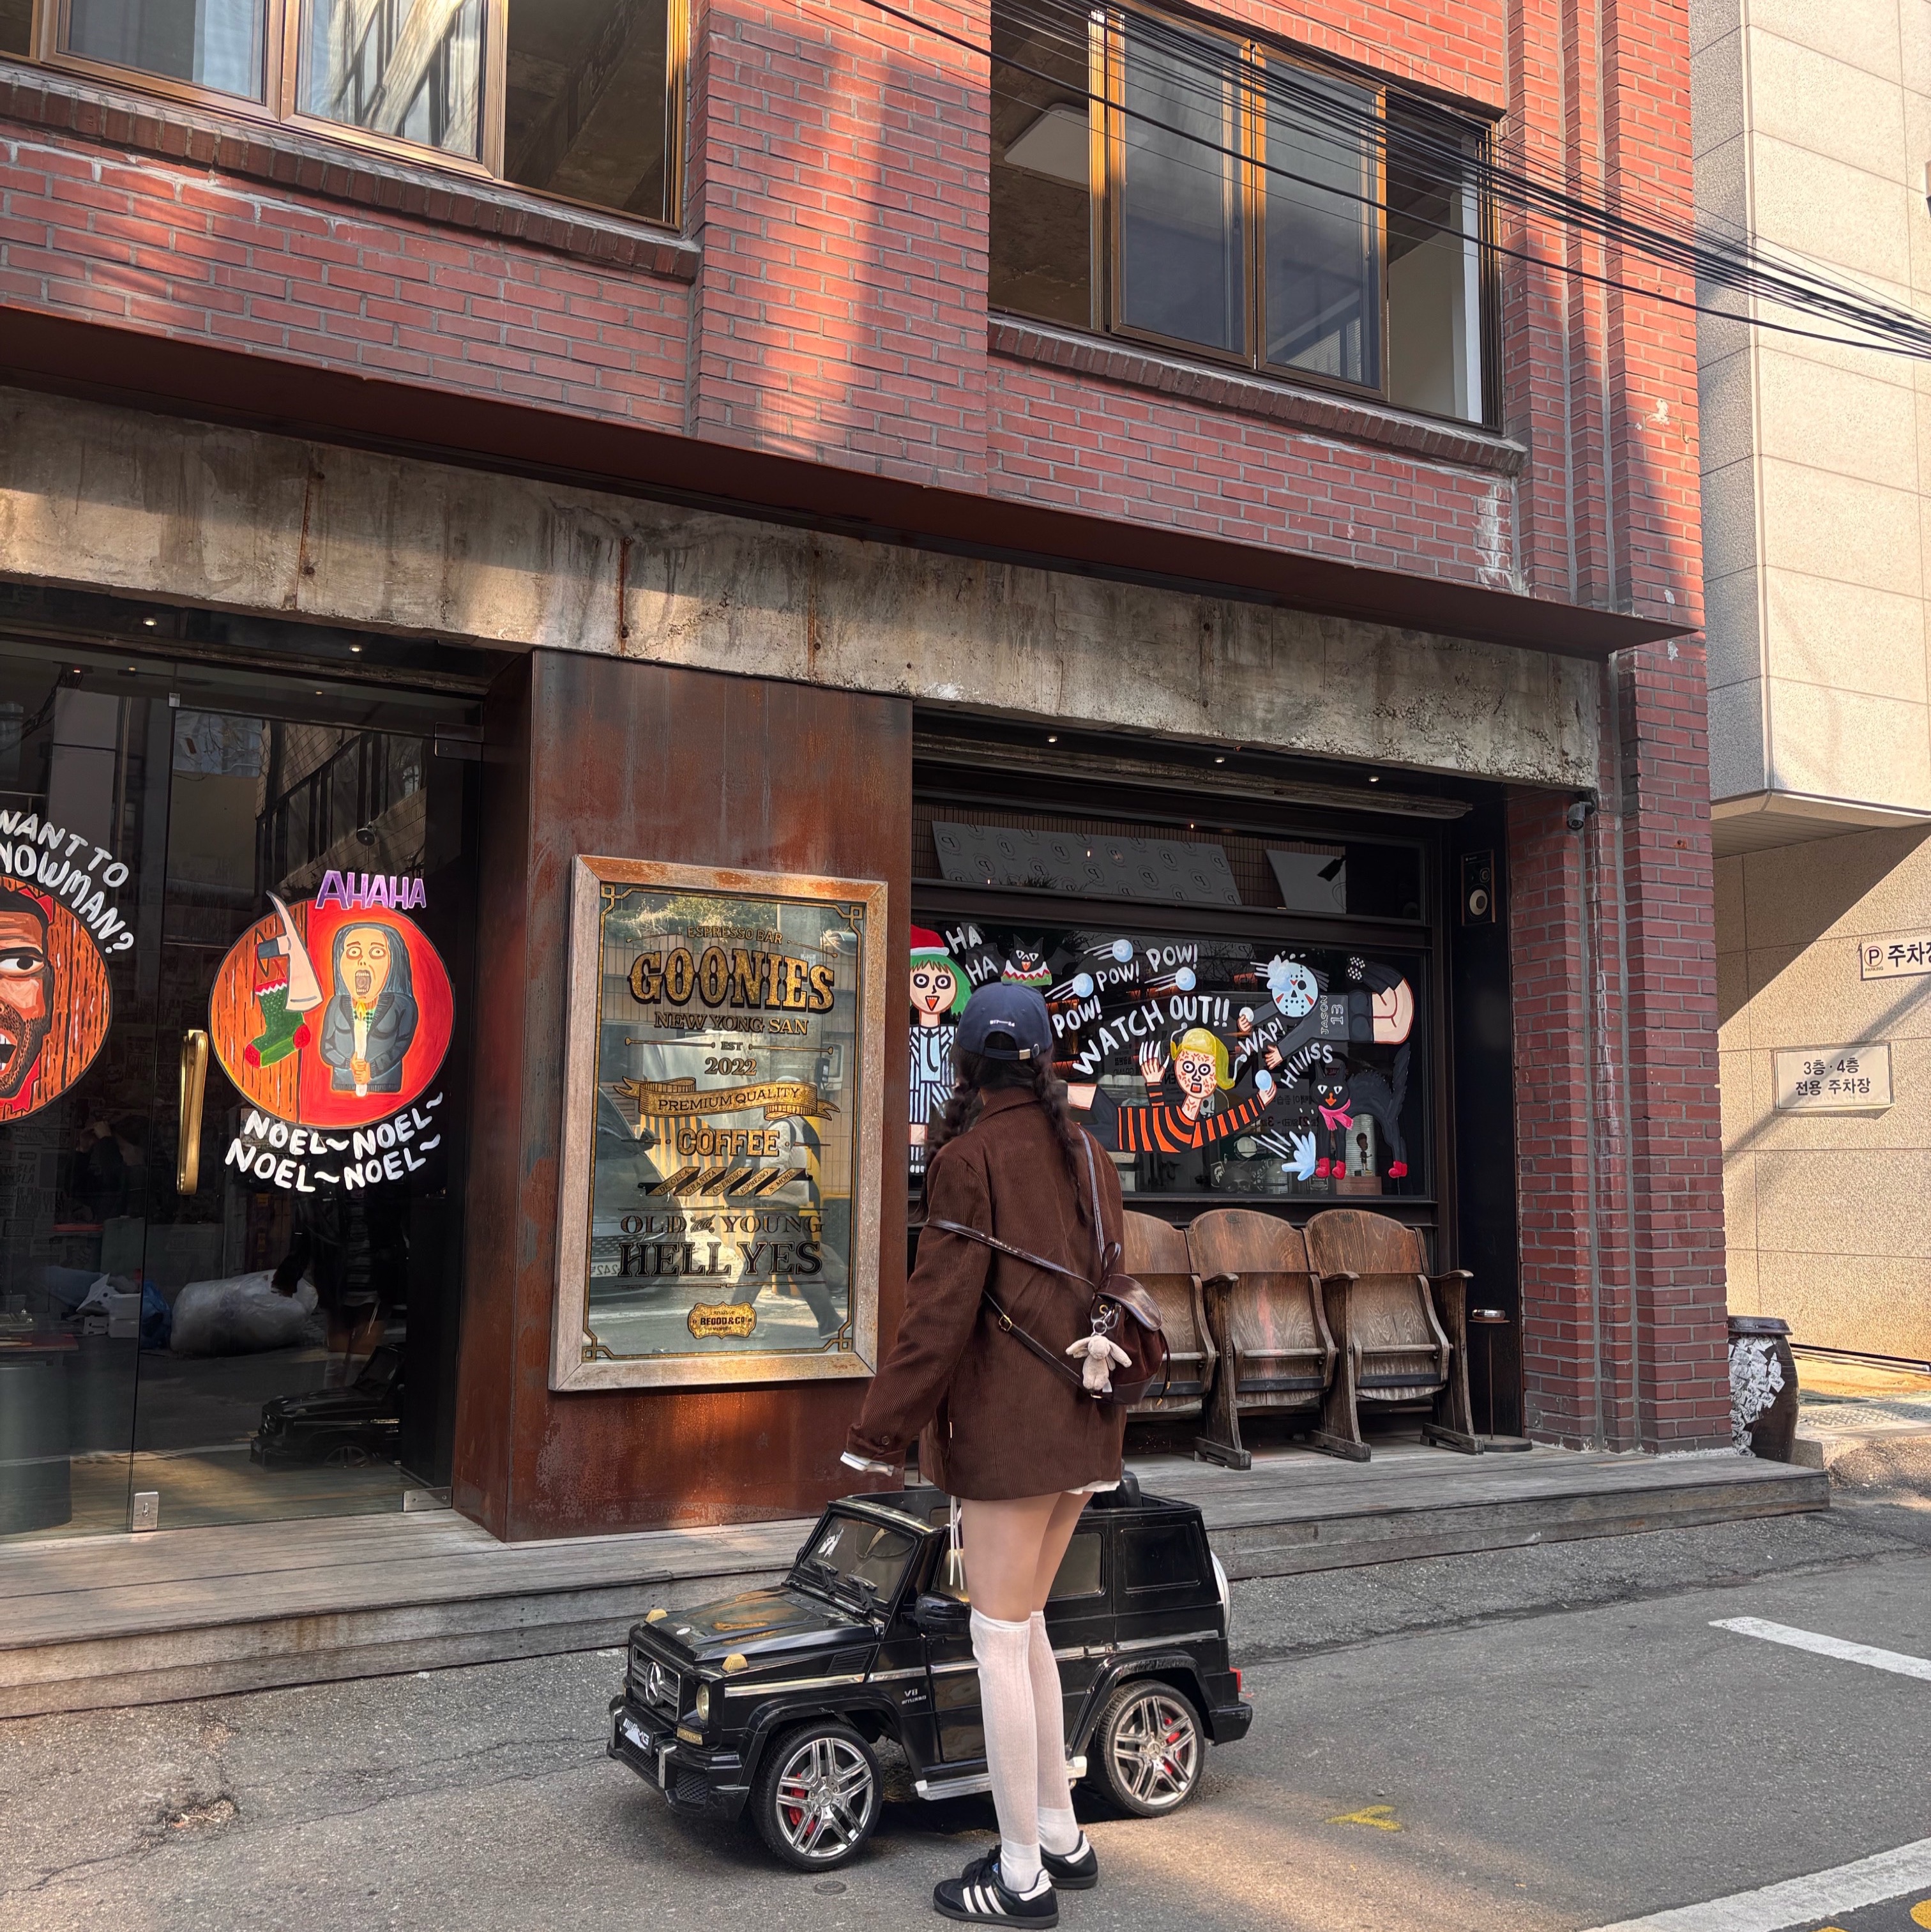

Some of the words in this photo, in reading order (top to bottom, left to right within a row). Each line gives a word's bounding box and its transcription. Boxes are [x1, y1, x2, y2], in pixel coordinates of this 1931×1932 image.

[0, 809, 88, 856] WANT
[94, 846, 128, 887] TO
[315, 870, 427, 910] AHAHA
[687, 926, 754, 939] ESPRESSO
[756, 929, 783, 945] BAR
[945, 925, 983, 955] HA
[966, 955, 999, 985] HA
[1146, 943, 1198, 972] POW!
[627, 946, 835, 1014] GOONIES
[1096, 962, 1140, 993] POW!
[654, 1011, 708, 1030] NEW
[710, 1014, 765, 1033] YONG
[768, 1018, 808, 1035] SAN
[1052, 995, 1103, 1038] POW!
[1321, 995, 1329, 1035] JASON
[1331, 1004, 1344, 1025] 13
[720, 1041, 743, 1051] EST
[1072, 999, 1165, 1075] WATCH
[1169, 995, 1230, 1028] OUT!!
[1238, 1017, 1286, 1056] WAP!
[704, 1056, 757, 1077] 2022
[658, 1093, 732, 1111] PREMIUM
[734, 1086, 801, 1104] QUALITY
[1796, 1079, 1822, 1097] 전용
[1828, 1077, 1871, 1095] 주차장
[678, 1128, 780, 1157] COFFEE
[659, 1183, 670, 1193] DE
[670, 1170, 690, 1185] OLLA
[686, 1171, 716, 1194] GRANITA
[741, 1171, 768, 1193] ESPRESSO
[620, 1215, 686, 1234] OLD
[719, 1215, 824, 1234] YOUNG
[617, 1242, 732, 1277] HELL
[738, 1240, 823, 1276] YES
[904, 1689, 918, 1697] V8
